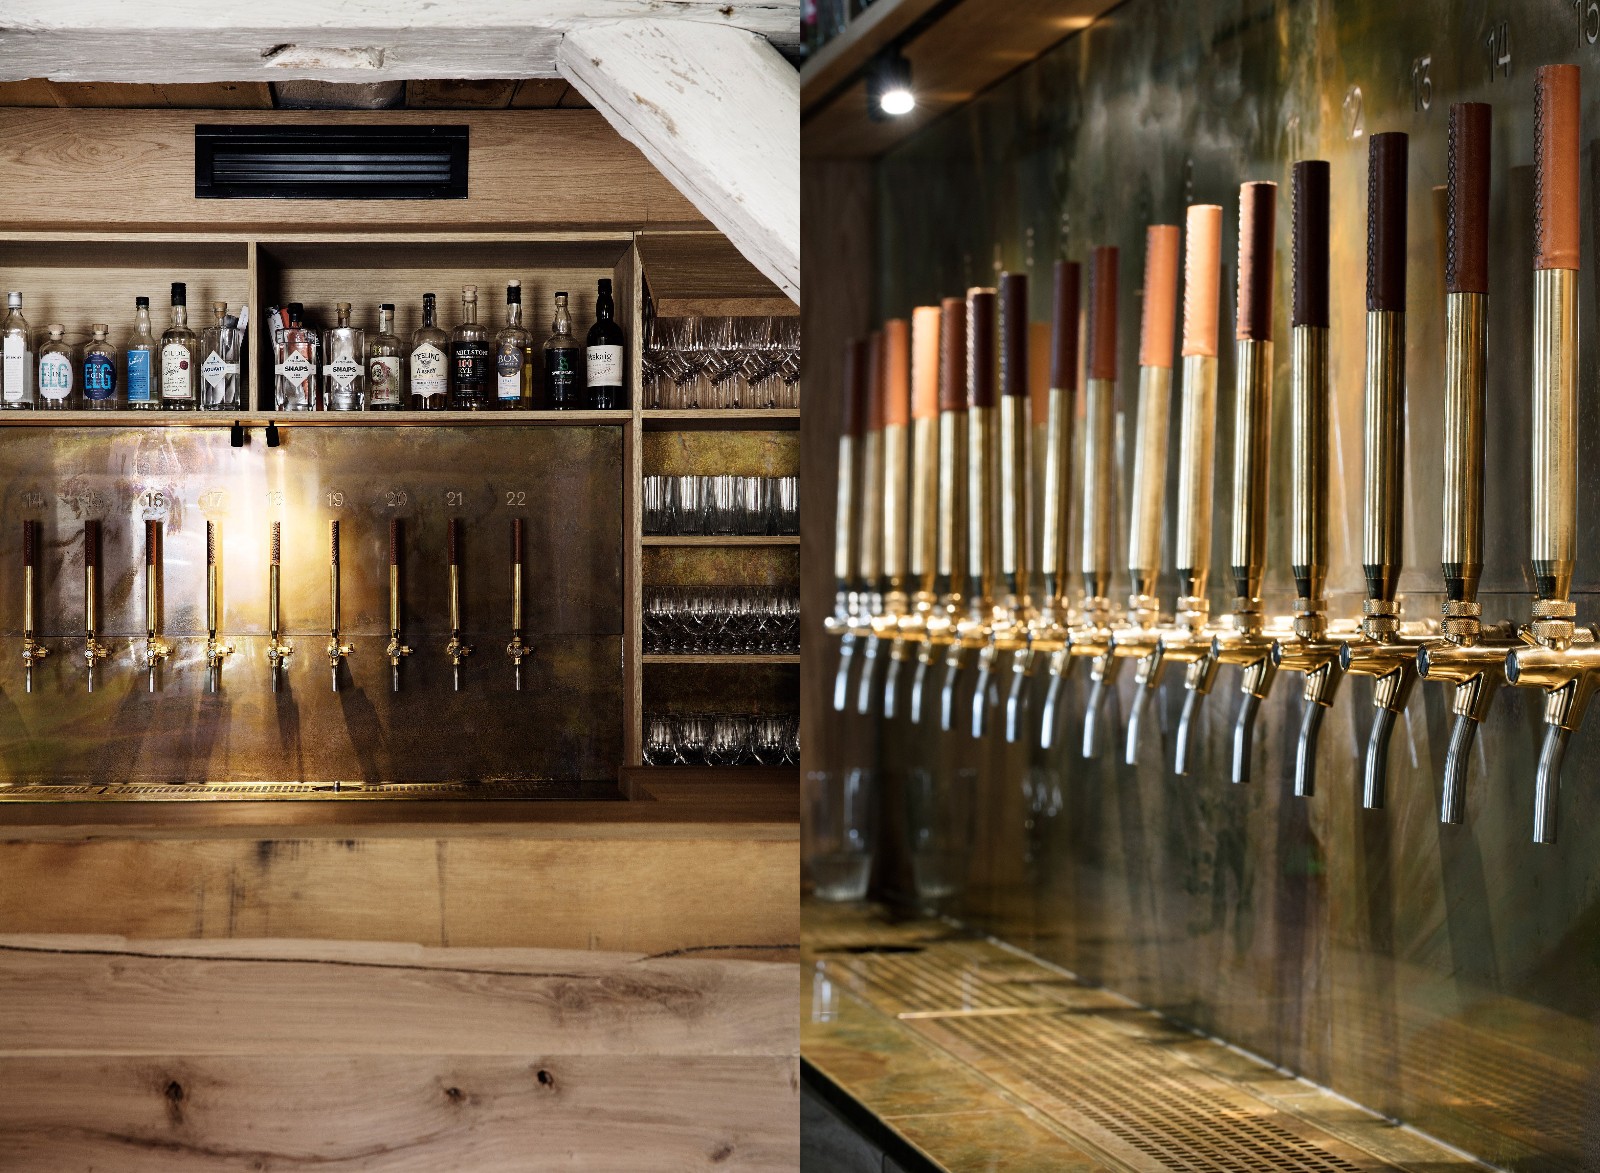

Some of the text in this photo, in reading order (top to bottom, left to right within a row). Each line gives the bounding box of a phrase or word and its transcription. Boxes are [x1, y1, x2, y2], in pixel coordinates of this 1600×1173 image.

[1487, 20, 1511, 83] 14
[1411, 54, 1432, 112] 13
[498, 353, 520, 364] BOX
[41, 362, 69, 389] ELG
[85, 363, 112, 389] ELG
[145, 492, 164, 508] 16
[326, 491, 344, 507] 19
[385, 491, 408, 507] 20
[446, 491, 463, 506] 21
[506, 491, 526, 506] 22
